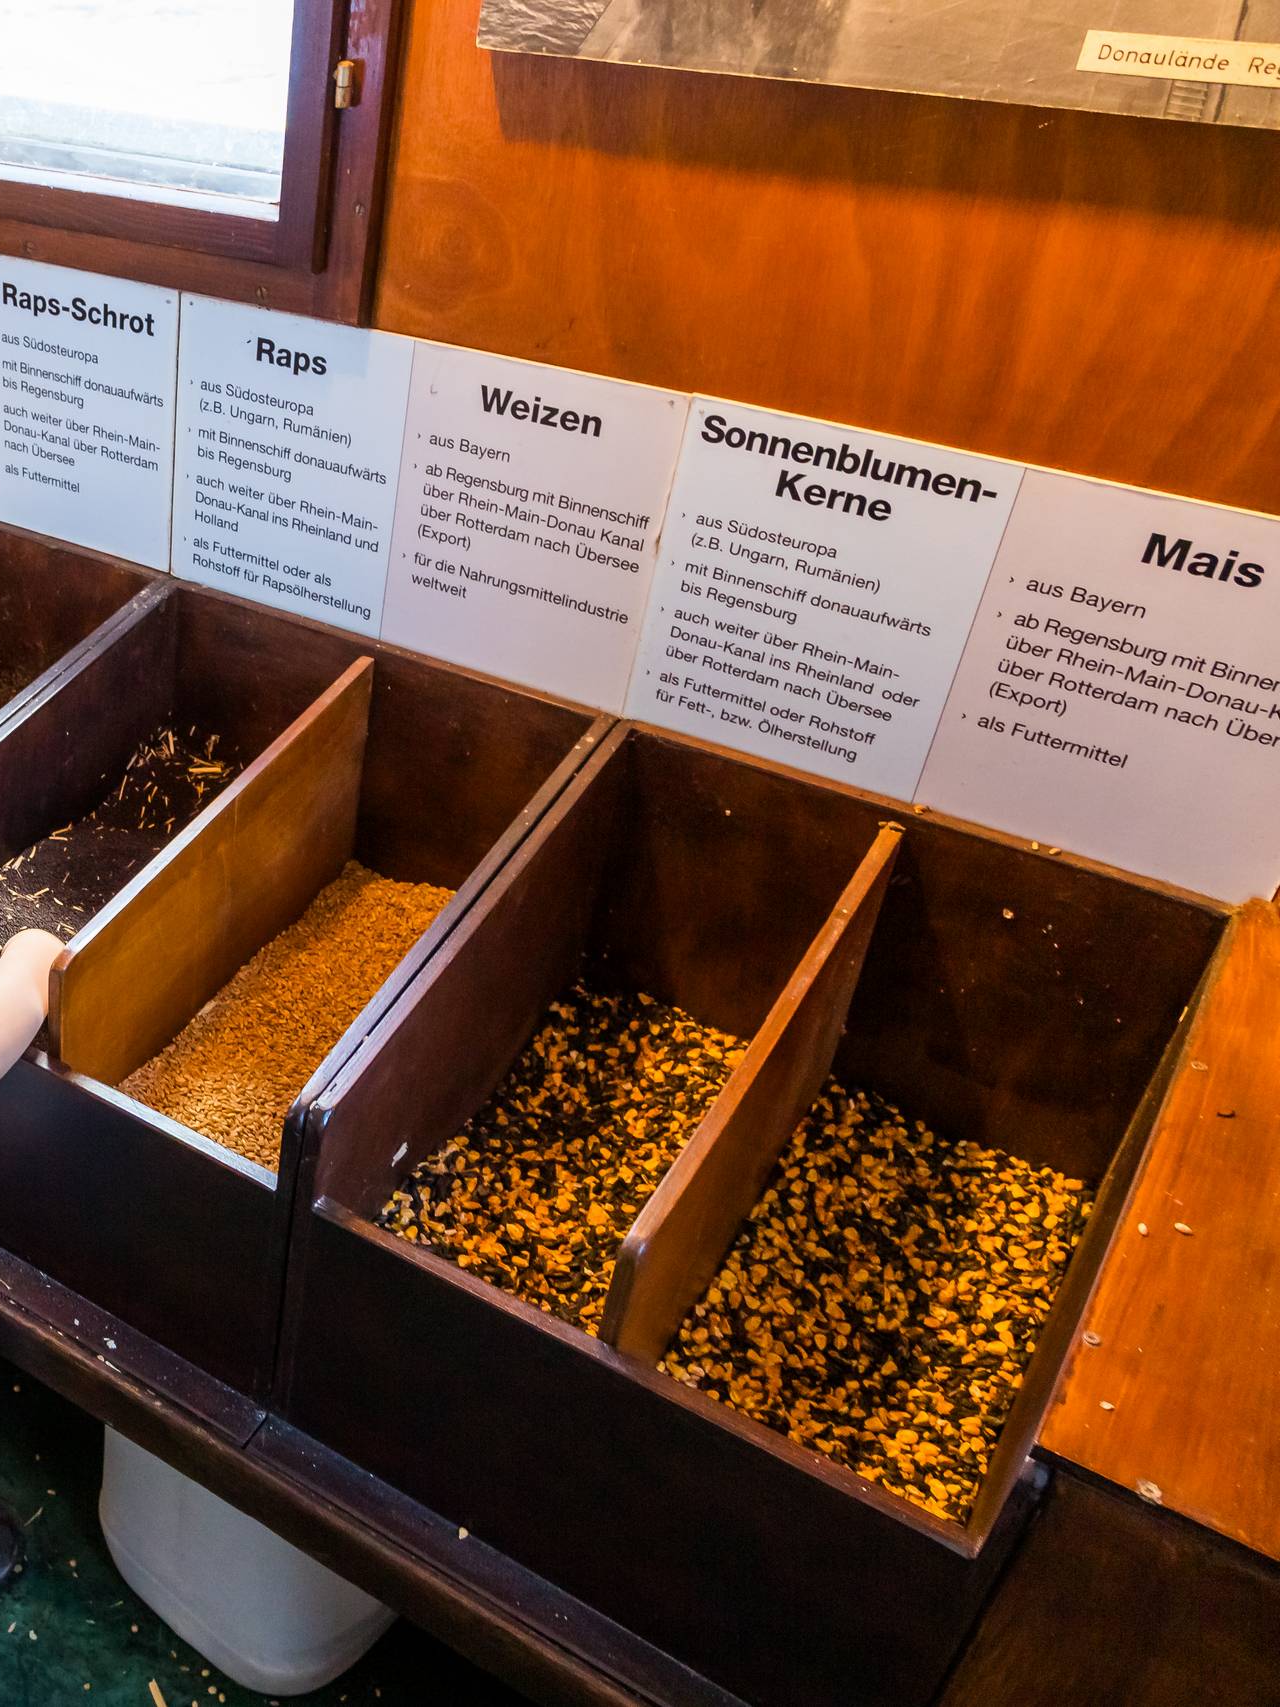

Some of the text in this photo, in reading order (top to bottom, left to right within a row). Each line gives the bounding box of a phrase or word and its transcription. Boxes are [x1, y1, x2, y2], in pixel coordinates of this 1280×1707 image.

[1098, 44, 1280, 80] Donaulände Re
[2, 282, 155, 336] Raps-Schrot
[1, 334, 99, 364] aus Südosteuropa
[256, 336, 328, 376] Raps
[2, 360, 164, 407] mit Binnenschiff donauaufwärts
[3, 377, 84, 409] bis Regensburg
[200, 380, 314, 416] aus Südosteuropa
[3, 404, 160, 451] auch weiter über Rhein-Main-
[199, 399, 351, 448] (z.B. Ungarn, Rumänien)
[481, 385, 602, 437] Weizen
[4, 421, 158, 471] Donau-Kanal über Rotterdam
[5, 439, 75, 466] nach Übersee
[198, 427, 386, 484] mit Binnenschiff donauaufwärts
[198, 446, 292, 482] bis Regensburg
[429, 434, 510, 462] aus Bayern
[701, 414, 998, 503] Sonnenblumen-
[5, 464, 80, 492] als Futtermittel
[196, 473, 378, 530] auch weiter über Rhein-Main-
[426, 464, 650, 530] ab Regensburg mit Binnenschiff
[775, 470, 892, 521] Kerne
[194, 510, 238, 532] Holland
[196, 492, 378, 552] Donau-Kanal ins Rheinland und
[417, 524, 471, 551] (Export)
[420, 504, 639, 573] über Rotterdam nach Übersee
[423, 484, 644, 551] über Rhein-Main-Donau Kanal
[696, 513, 838, 559] aus Südosteuropa
[193, 536, 331, 586] als Futtermittel oder als
[691, 533, 881, 594] (z.B. Ungarn, Rumänien)
[1141, 532, 1265, 588] Mais
[192, 554, 371, 620] Rohstoff für Rapsölherstellung
[412, 574, 467, 599] weltweit
[414, 552, 629, 624] für die Nahrungsmittelindustrie
[681, 580, 798, 625] bis Regensburg
[685, 560, 932, 637] mit Binnenschiff donauaufwärts
[1026, 578, 1146, 618] aus Bayern
[670, 626, 921, 708] Donau-Kanal ins Rheinland oder
[674, 608, 900, 680] auch weiter über Rhein-Main-
[1005, 635, 1053, 659] über
[1014, 612, 1040, 630] ab
[1044, 618, 1167, 666] Regensburg
[1171, 654, 1206, 674] mit
[660, 671, 876, 745] als Futtermittel oder Rohstoff
[666, 646, 893, 722] über Rotterdam nach Übersee
[989, 681, 1068, 717] (Export)
[997, 658, 1044, 682] über
[1048, 671, 1158, 714] Rotterdam
[1164, 706, 1219, 731] nach
[656, 688, 858, 763] für Fett-, bzw. Ölherstellung
[977, 714, 1128, 769] als Futtermittel
